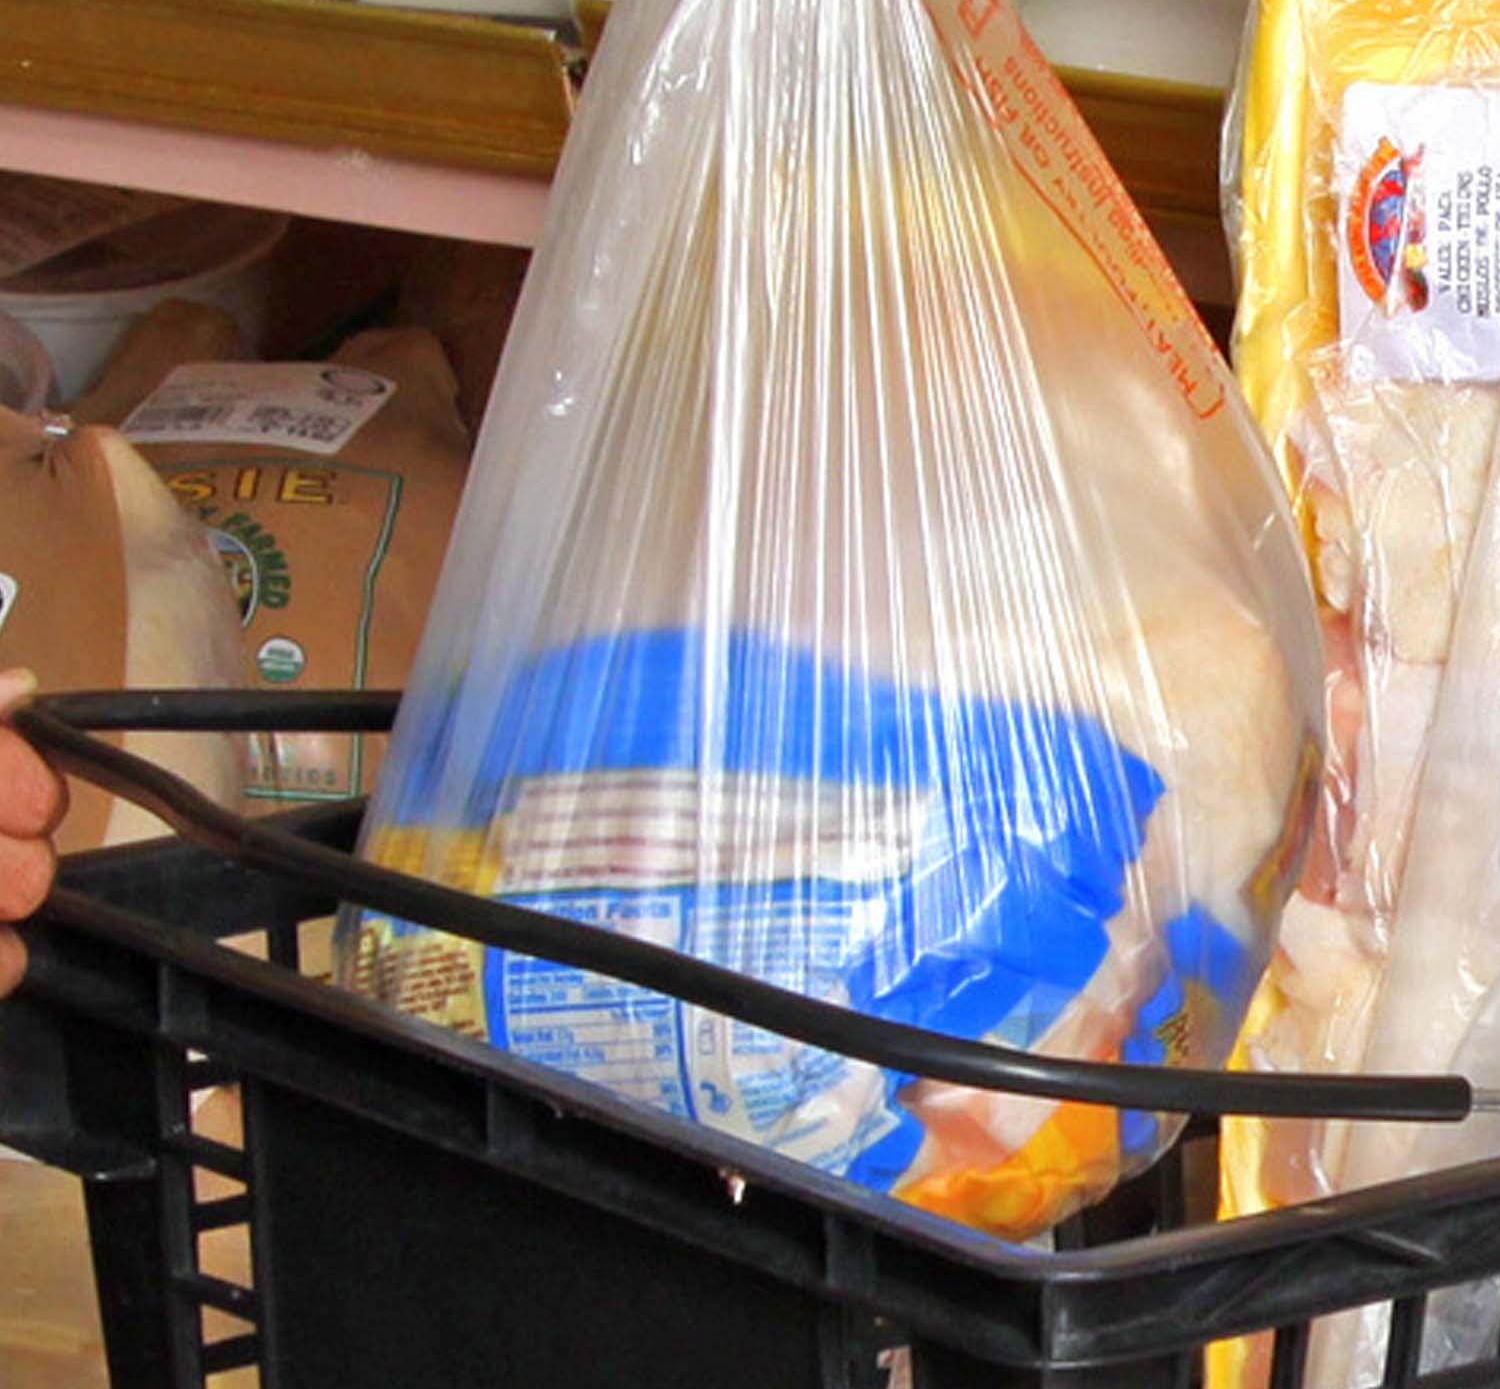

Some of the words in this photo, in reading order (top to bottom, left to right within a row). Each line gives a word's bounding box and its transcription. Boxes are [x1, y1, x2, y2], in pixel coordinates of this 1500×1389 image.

[1475, 165, 1493, 216] POLLO
[165, 466, 336, 504] SIE
[222, 512, 293, 609] FARMED
